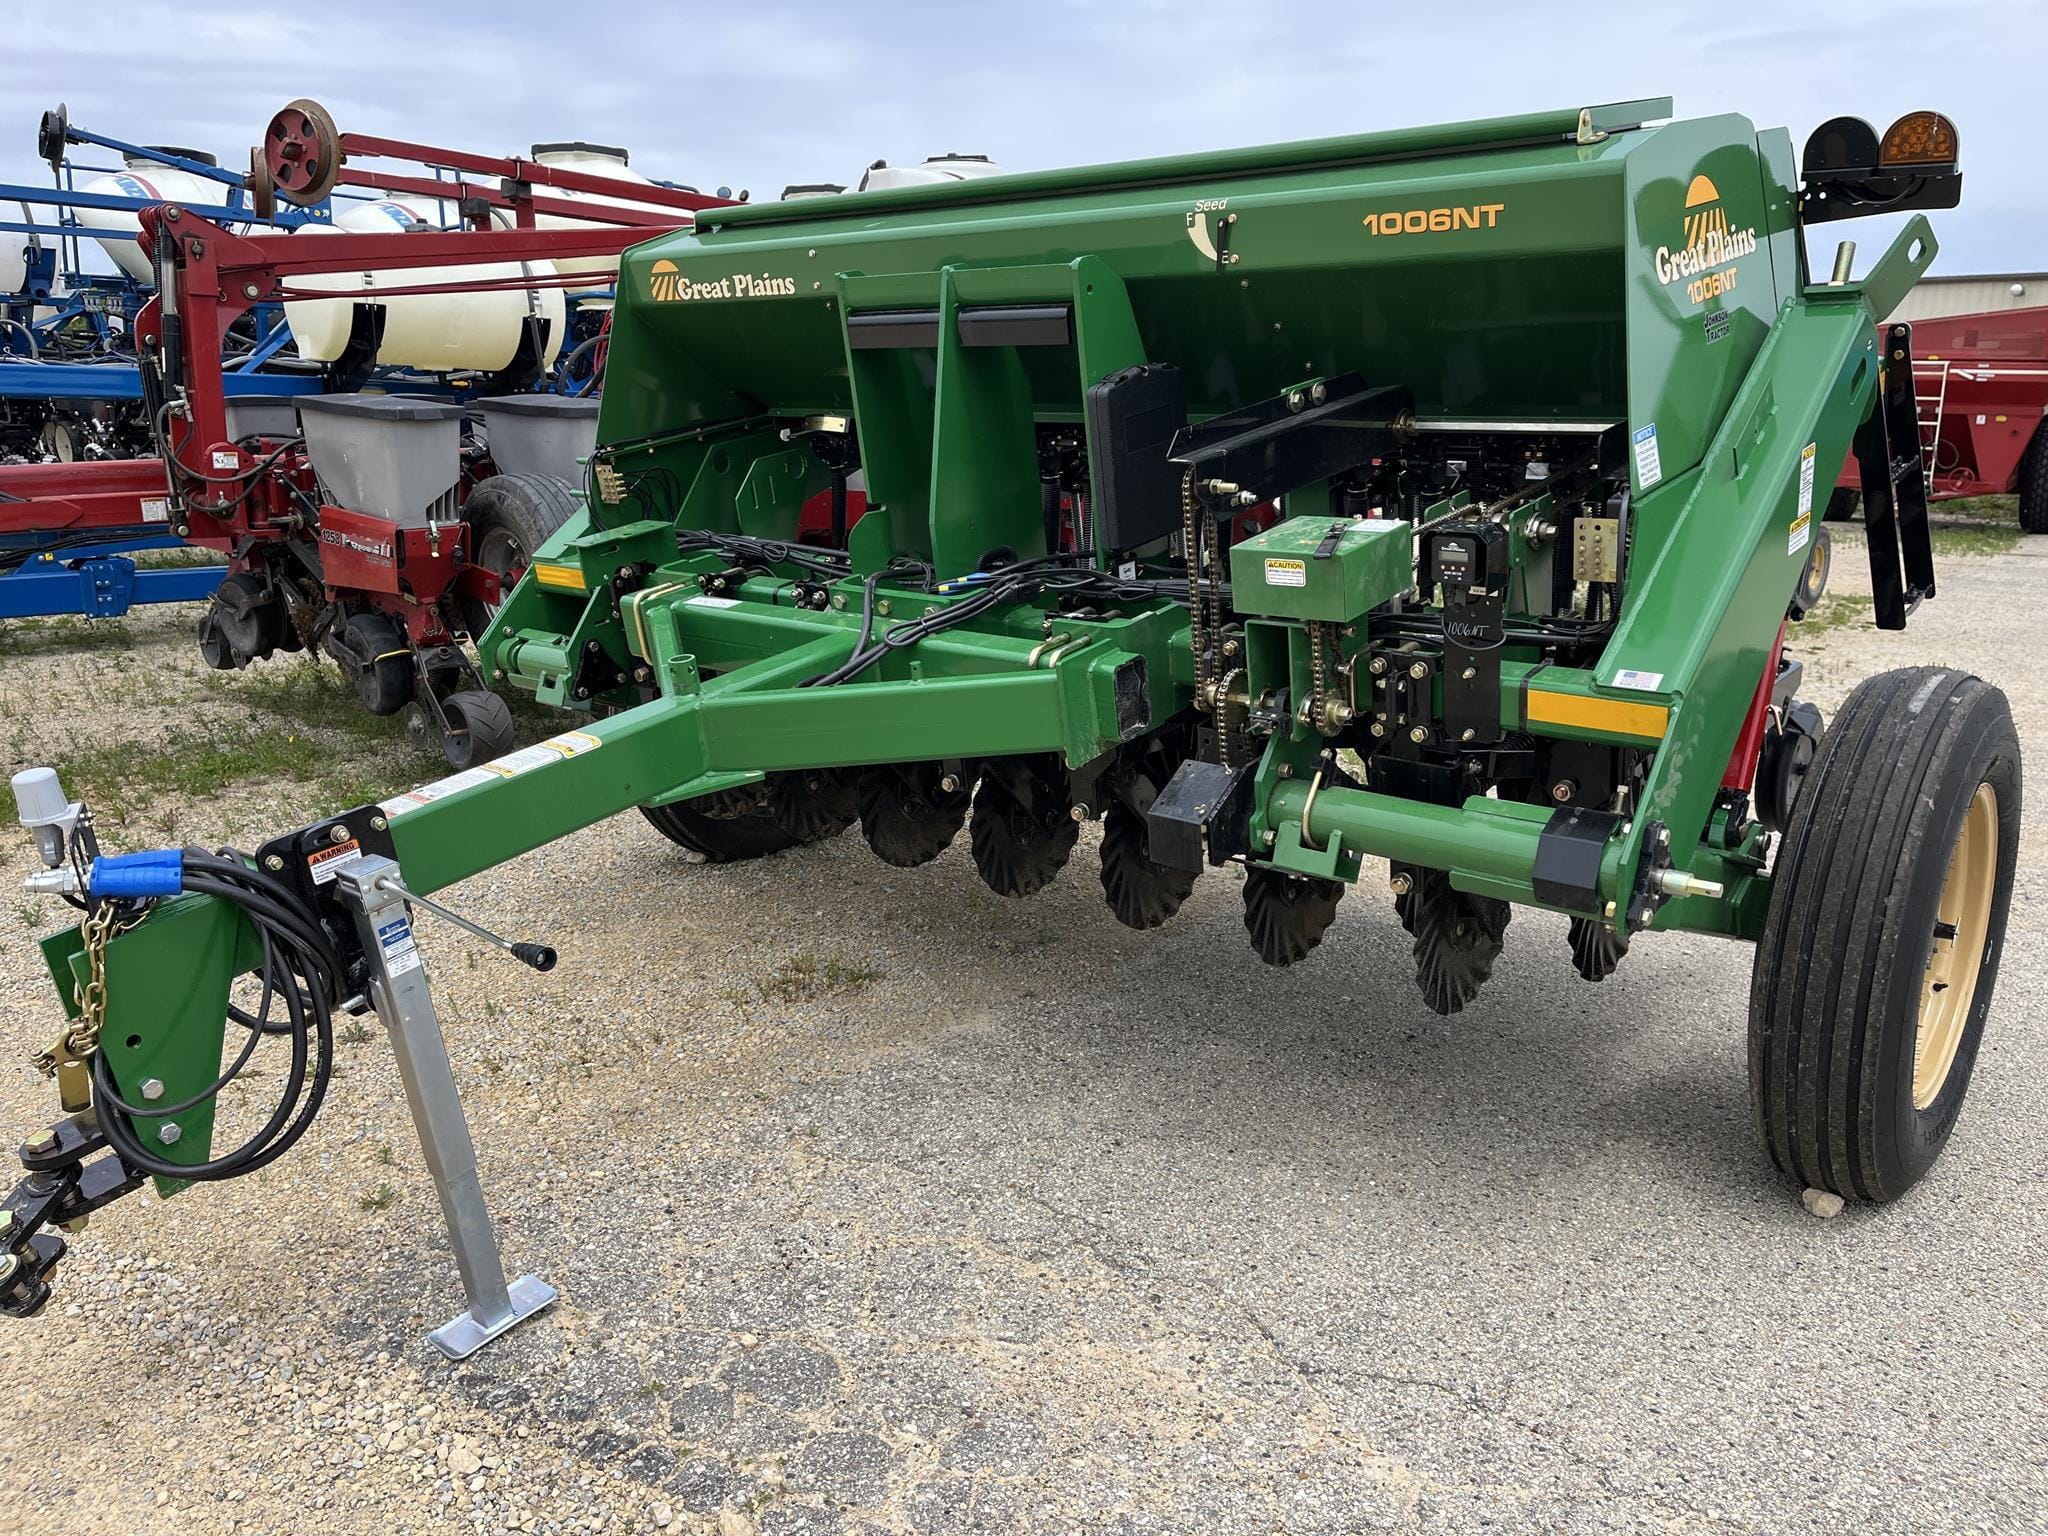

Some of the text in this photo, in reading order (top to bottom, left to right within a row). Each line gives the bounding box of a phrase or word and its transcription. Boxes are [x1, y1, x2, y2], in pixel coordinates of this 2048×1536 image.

[1194, 198, 1229, 212] Seed
[1186, 212, 1193, 226] F
[1362, 203, 1505, 236] 1006NT
[1655, 223, 1757, 285] Great Plains
[677, 272, 795, 300] Great Plains
[1687, 267, 1737, 304] 1006NT
[1704, 309, 1729, 328] JOHNSON
[1705, 324, 1731, 343] TRACTOR
[1273, 561, 1302, 569] CAUTION
[1447, 621, 1491, 637] 1006NT
[319, 842, 355, 861] WARNING
